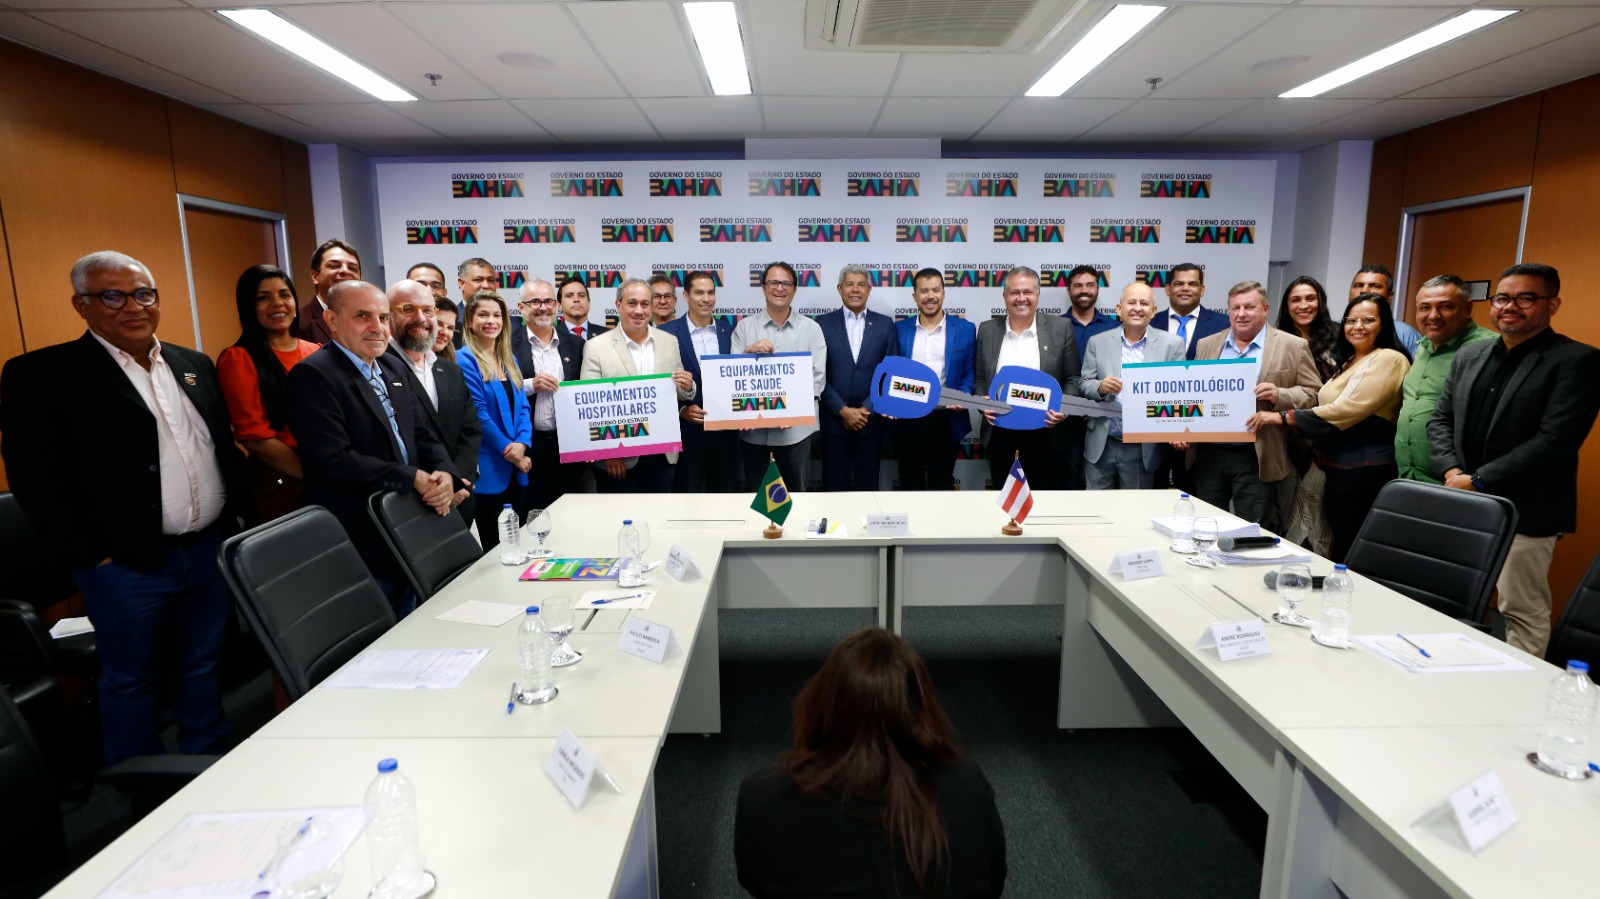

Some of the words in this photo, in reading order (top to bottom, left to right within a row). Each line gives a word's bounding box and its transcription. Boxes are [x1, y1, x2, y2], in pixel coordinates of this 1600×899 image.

[452, 180, 524, 198] BAHIA
[550, 179, 623, 196] BAHIA
[649, 179, 722, 196] BAHIA
[748, 179, 821, 196] BAHIA
[848, 179, 919, 196] BAHIA
[946, 179, 1017, 196] BAHIA
[1044, 180, 1114, 197] BAHIA
[1140, 180, 1211, 198] BAHIA
[407, 227, 478, 244] BAHIA
[504, 226, 575, 243] BAHIA
[602, 225, 673, 242] BAHIA
[700, 225, 772, 242] BAHIA
[799, 225, 870, 242] BAHIA
[896, 225, 967, 242] BAHIA
[993, 225, 1064, 242] BAHIA
[1090, 226, 1160, 243] BAHIA
[1185, 227, 1255, 244] BAHIA
[720, 363, 795, 377] EQUIPAMENTOS
[735, 379, 747, 391] DE
[750, 377, 782, 390] SAÚDE
[893, 382, 926, 394] BAHIA
[1133, 381, 1151, 394] KIT
[1155, 376, 1245, 393] ODONTOLÓGICO
[574, 387, 657, 405] EQUIPAMENTOS
[732, 397, 786, 411] BAHIA
[1011, 389, 1047, 402] BAHIA
[578, 402, 656, 420] HOSPITALARES
[1146, 405, 1203, 417] BAHIA
[589, 422, 650, 441] BAHIA
